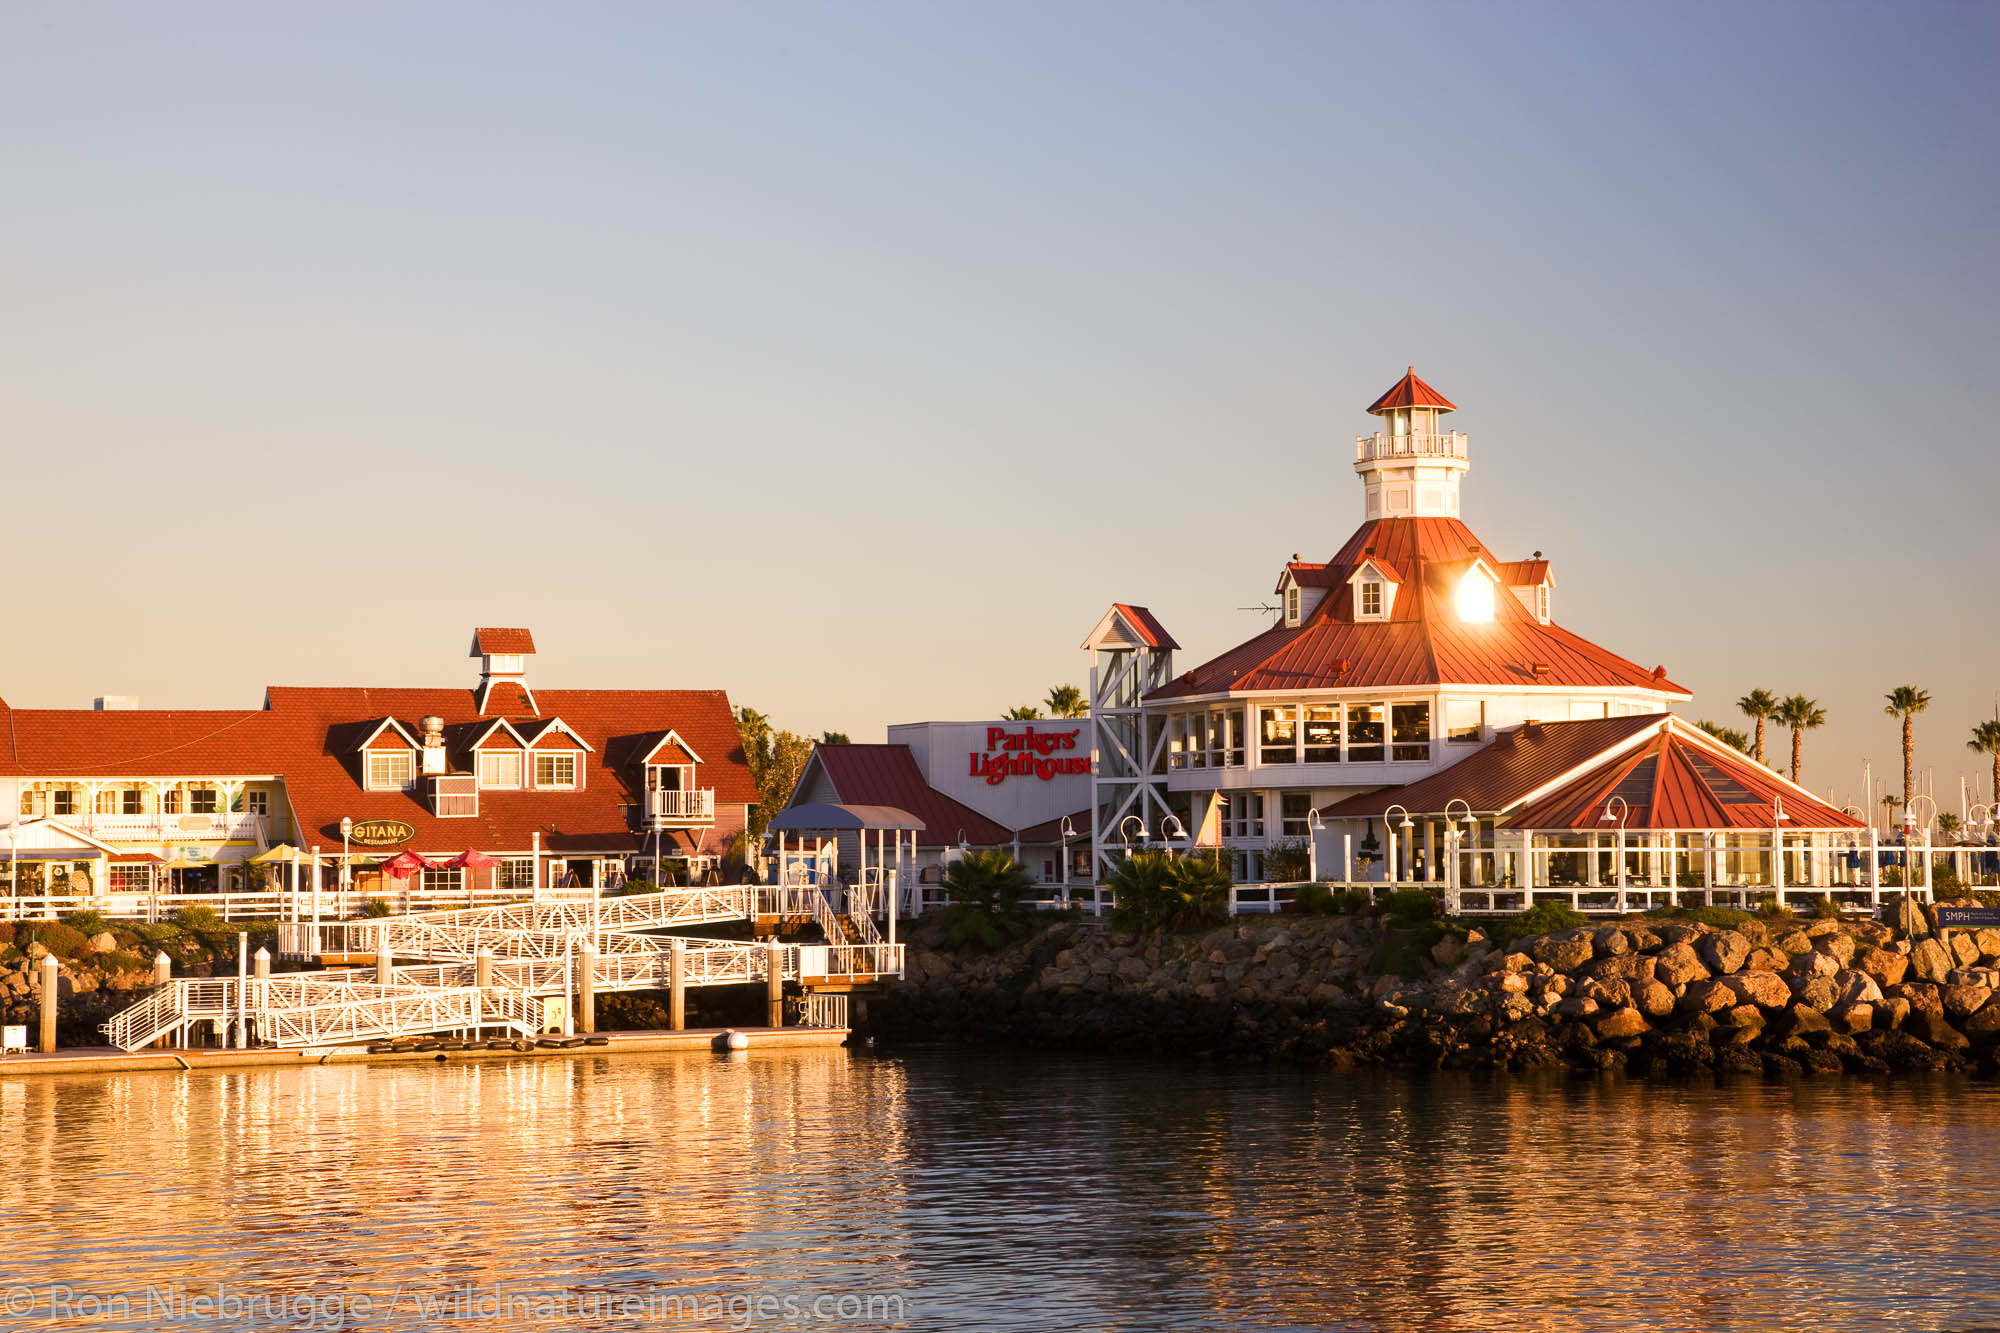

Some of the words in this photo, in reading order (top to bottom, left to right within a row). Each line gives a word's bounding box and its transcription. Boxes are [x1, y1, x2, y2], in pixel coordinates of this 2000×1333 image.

[986, 726, 1080, 755] Parkers'
[354, 825, 407, 838] GITANA
[363, 837, 399, 845] RESTAURANT
[1945, 911, 1970, 921] SMPH
